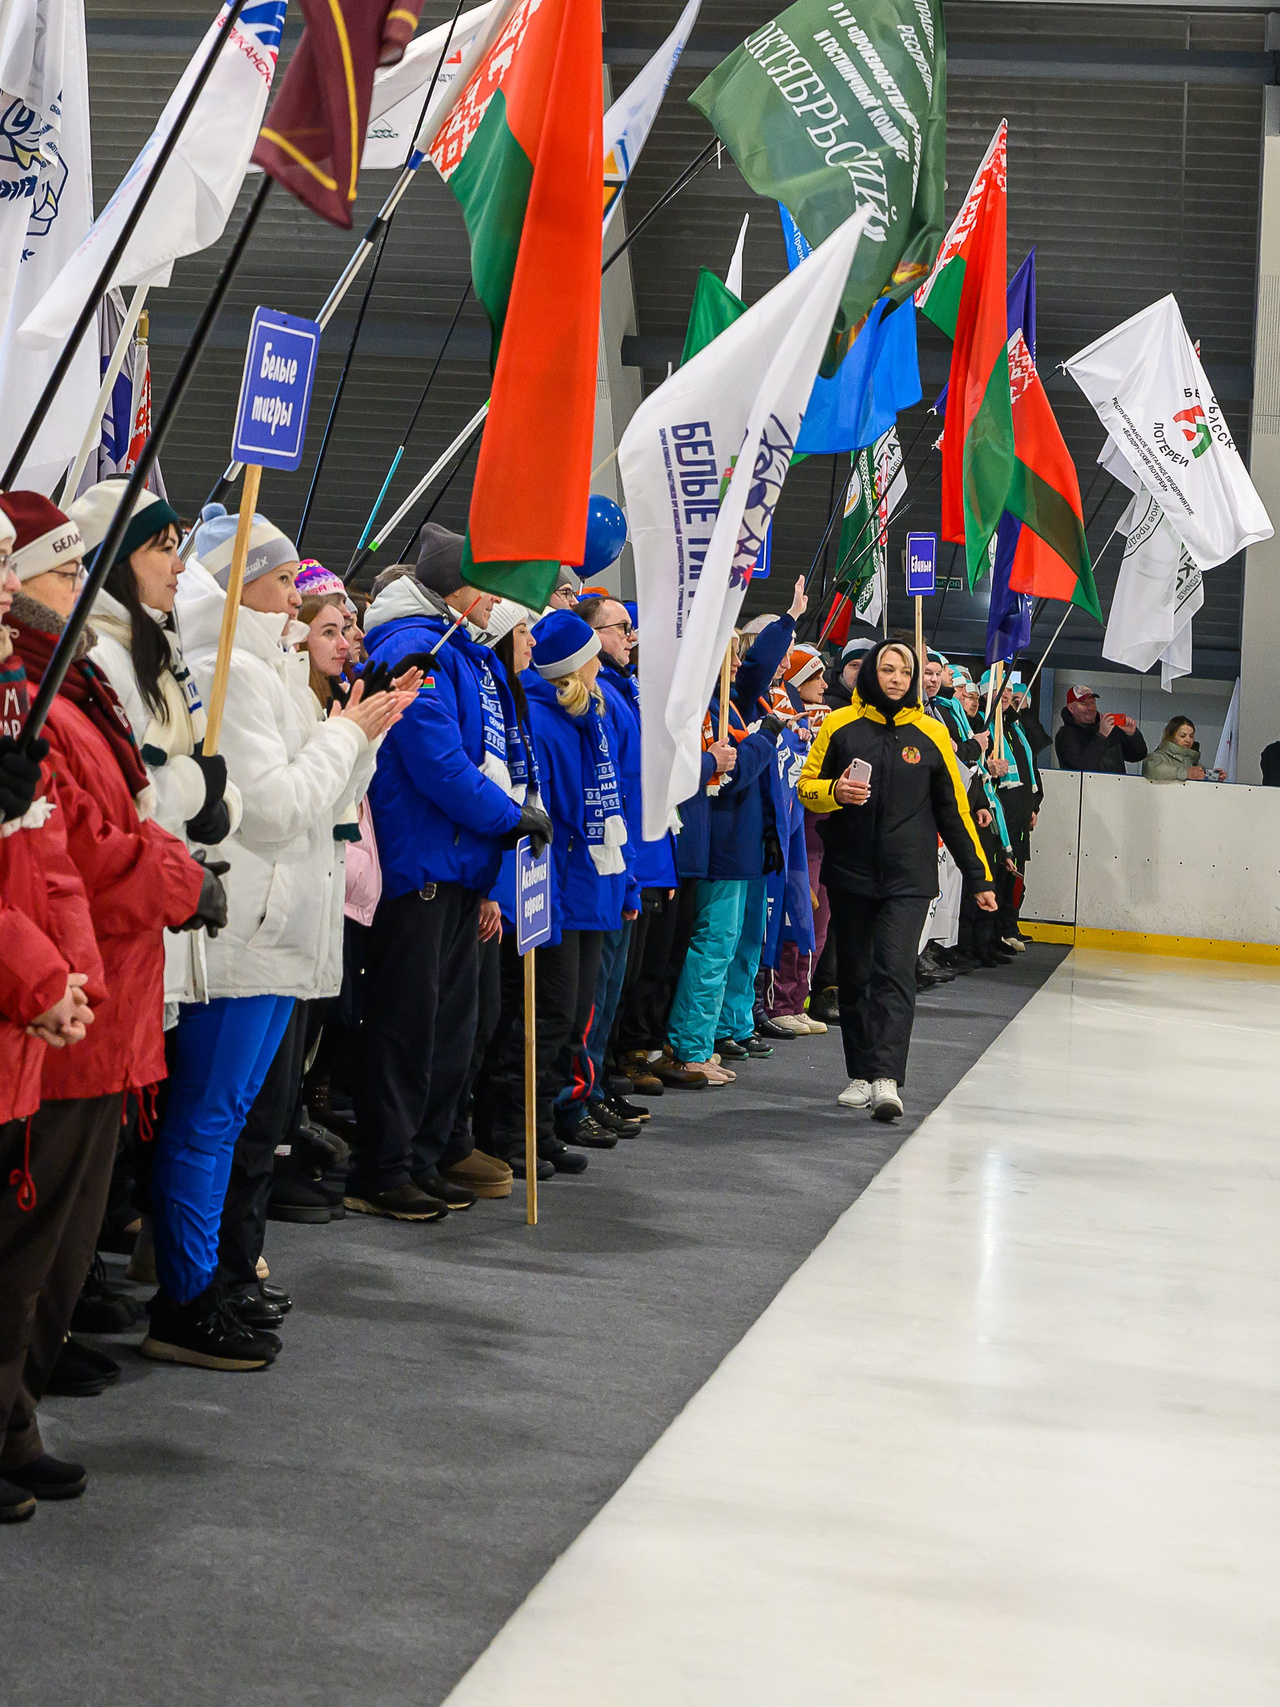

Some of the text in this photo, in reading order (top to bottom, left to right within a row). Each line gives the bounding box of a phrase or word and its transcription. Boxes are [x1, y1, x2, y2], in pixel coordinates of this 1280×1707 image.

[260, 341, 298, 385] Белые
[251, 395, 293, 436] тигры
[1154, 422, 1190, 468] ЛОТЕРЕИ
[671, 421, 720, 524] БЕЛЫЕ
[1165, 474, 1194, 517] ПРЕДПРИЯТИЕ
